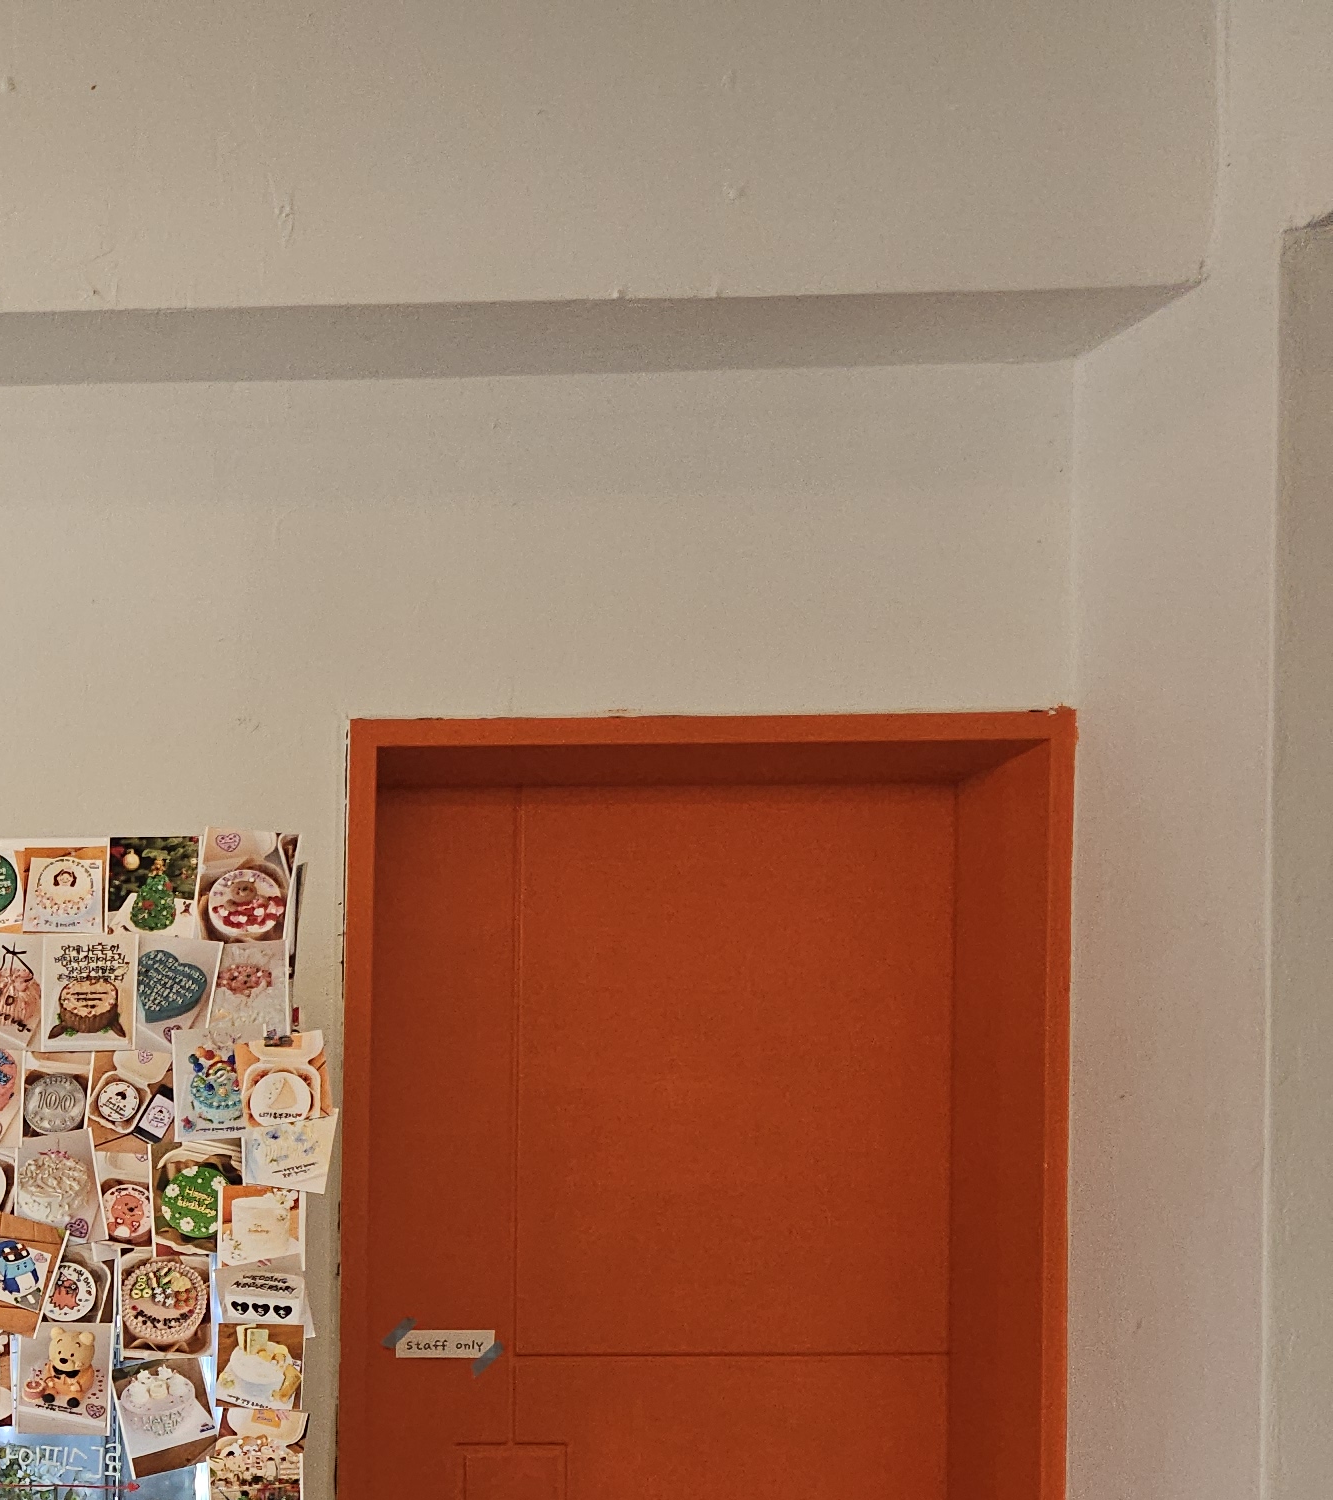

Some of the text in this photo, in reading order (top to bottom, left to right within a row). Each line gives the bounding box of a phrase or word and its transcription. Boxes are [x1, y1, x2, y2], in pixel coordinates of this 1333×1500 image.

[37, 1088, 76, 1113] 100
[242, 1274, 289, 1285] WEDDING
[230, 1280, 296, 1295] ANNIVERSARY
[455, 1339, 484, 1353] only
